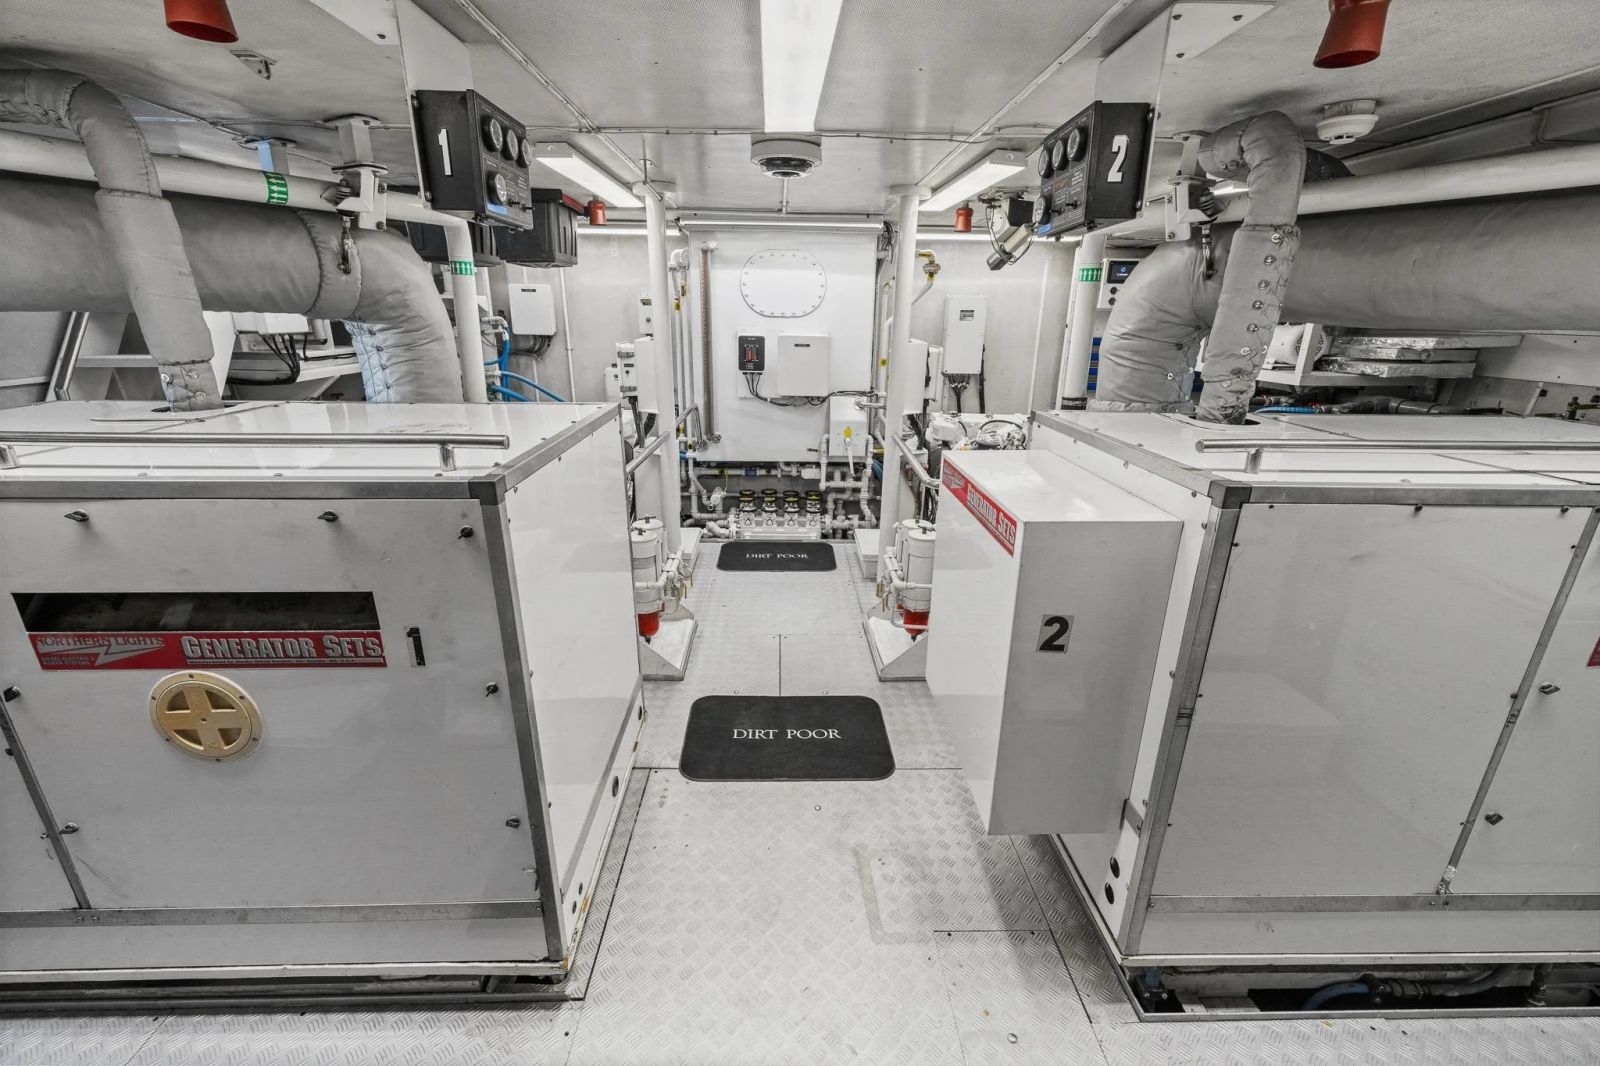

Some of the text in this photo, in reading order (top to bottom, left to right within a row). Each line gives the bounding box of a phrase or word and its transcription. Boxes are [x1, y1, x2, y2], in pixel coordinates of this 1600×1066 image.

[438, 128, 452, 176] 1
[1107, 134, 1129, 182] 2
[967, 483, 997, 530] GENERATOR
[998, 511, 1016, 545] SETS
[36, 636, 164, 646] NORTHERN LIGHTS
[180, 635, 382, 659] GENERATOR SETS
[407, 627, 426, 666] 1
[1039, 616, 1069, 651] 2
[732, 729, 842, 740] DIRT POOR
